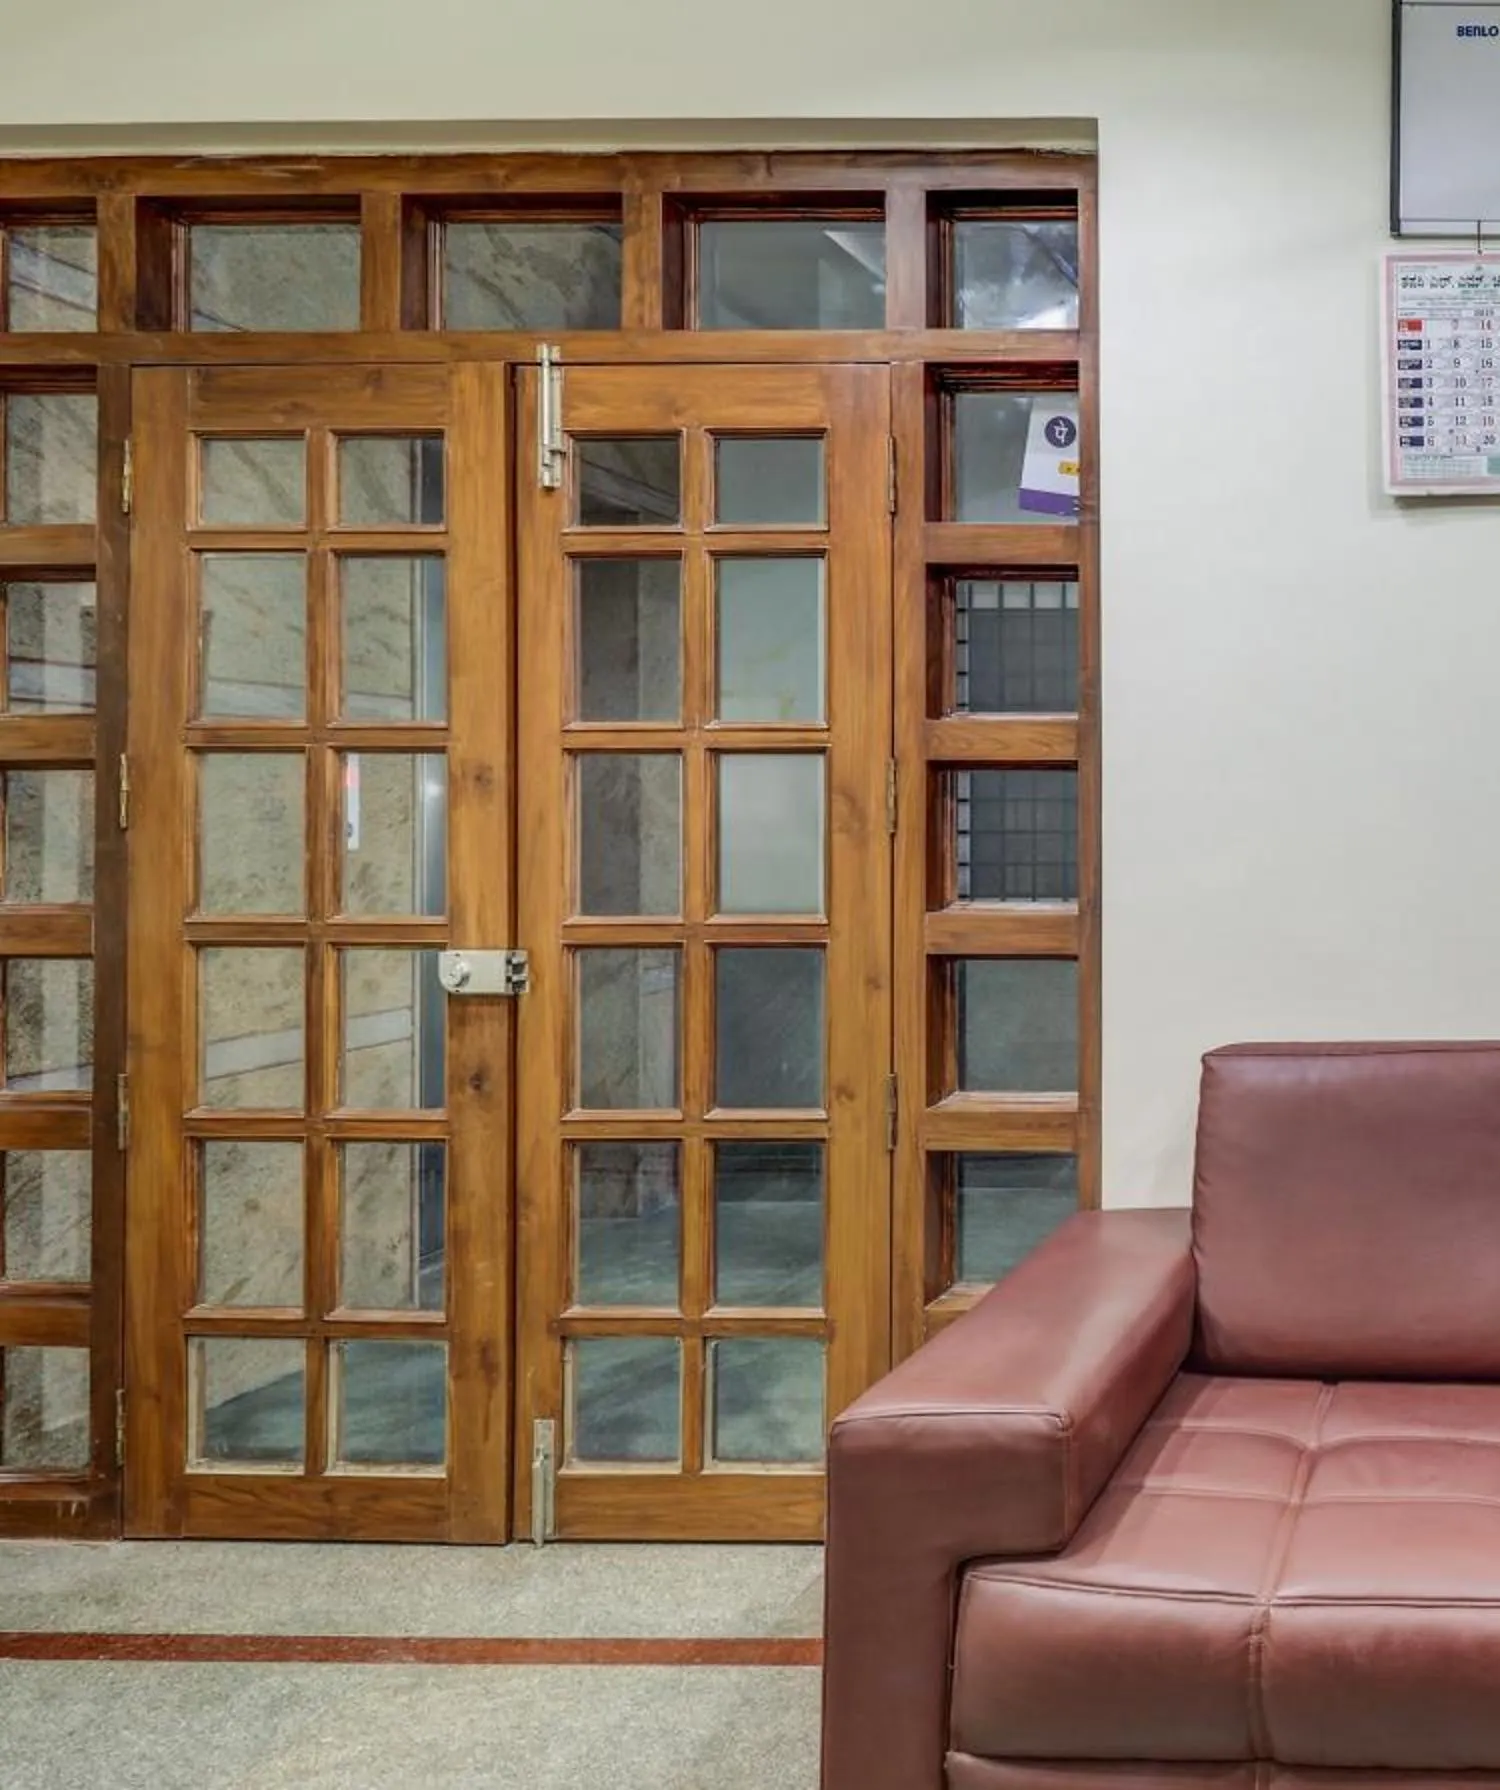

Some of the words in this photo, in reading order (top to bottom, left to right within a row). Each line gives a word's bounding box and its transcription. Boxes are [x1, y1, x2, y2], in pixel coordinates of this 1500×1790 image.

[1456, 25, 1500, 37] BENLO
[1480, 319, 1493, 330] 14
[1480, 339, 1493, 349] 15
[1480, 358, 1493, 369] 16
[1455, 377, 1467, 388] 10
[1481, 377, 1493, 388] 17
[1455, 396, 1466, 407] 11
[1455, 415, 1467, 426] 12
